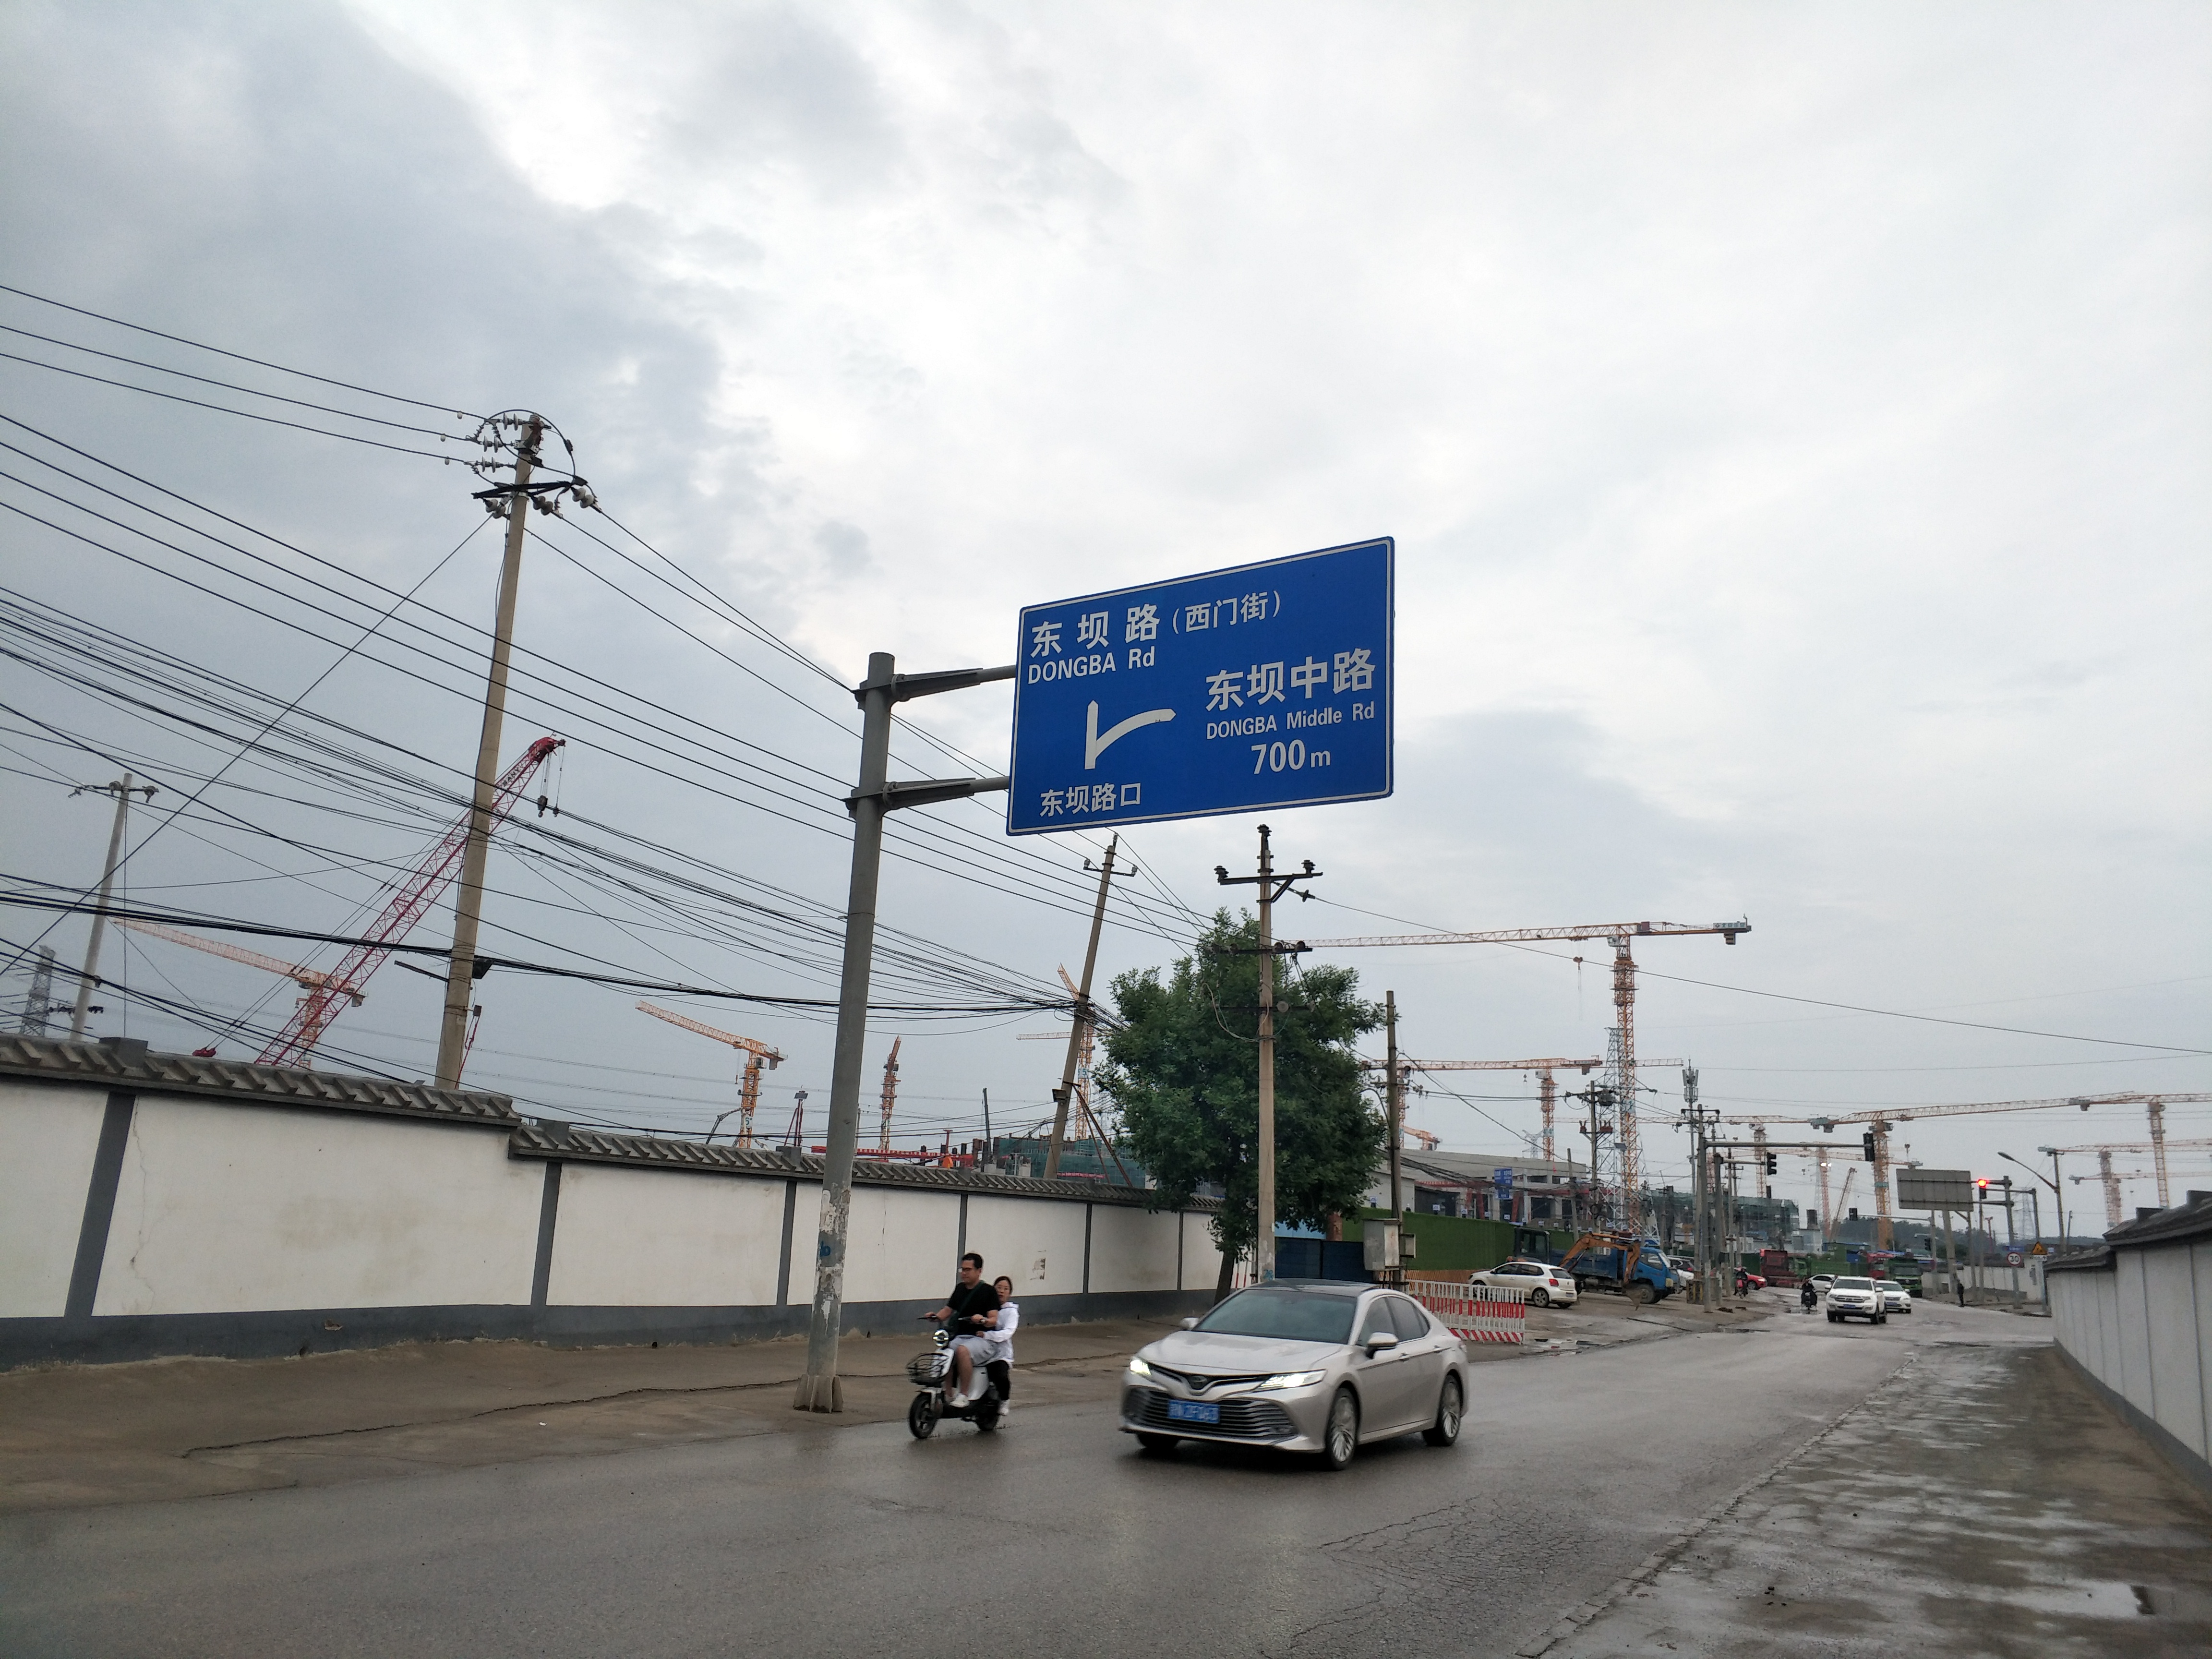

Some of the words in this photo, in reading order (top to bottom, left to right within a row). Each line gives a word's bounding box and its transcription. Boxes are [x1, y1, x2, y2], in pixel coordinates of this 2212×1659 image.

[1031, 603, 1160, 658] 东坝路
[1028, 652, 1116, 684] DONGBA
[1128, 646, 1155, 669] Rd
[1205, 648, 1376, 712] 东坝中路
[1207, 715, 1277, 740] DONGBA
[1287, 707, 1342, 730] Middle
[1353, 701, 1374, 721] Rd
[1040, 782, 1142, 817] 东坝路口
